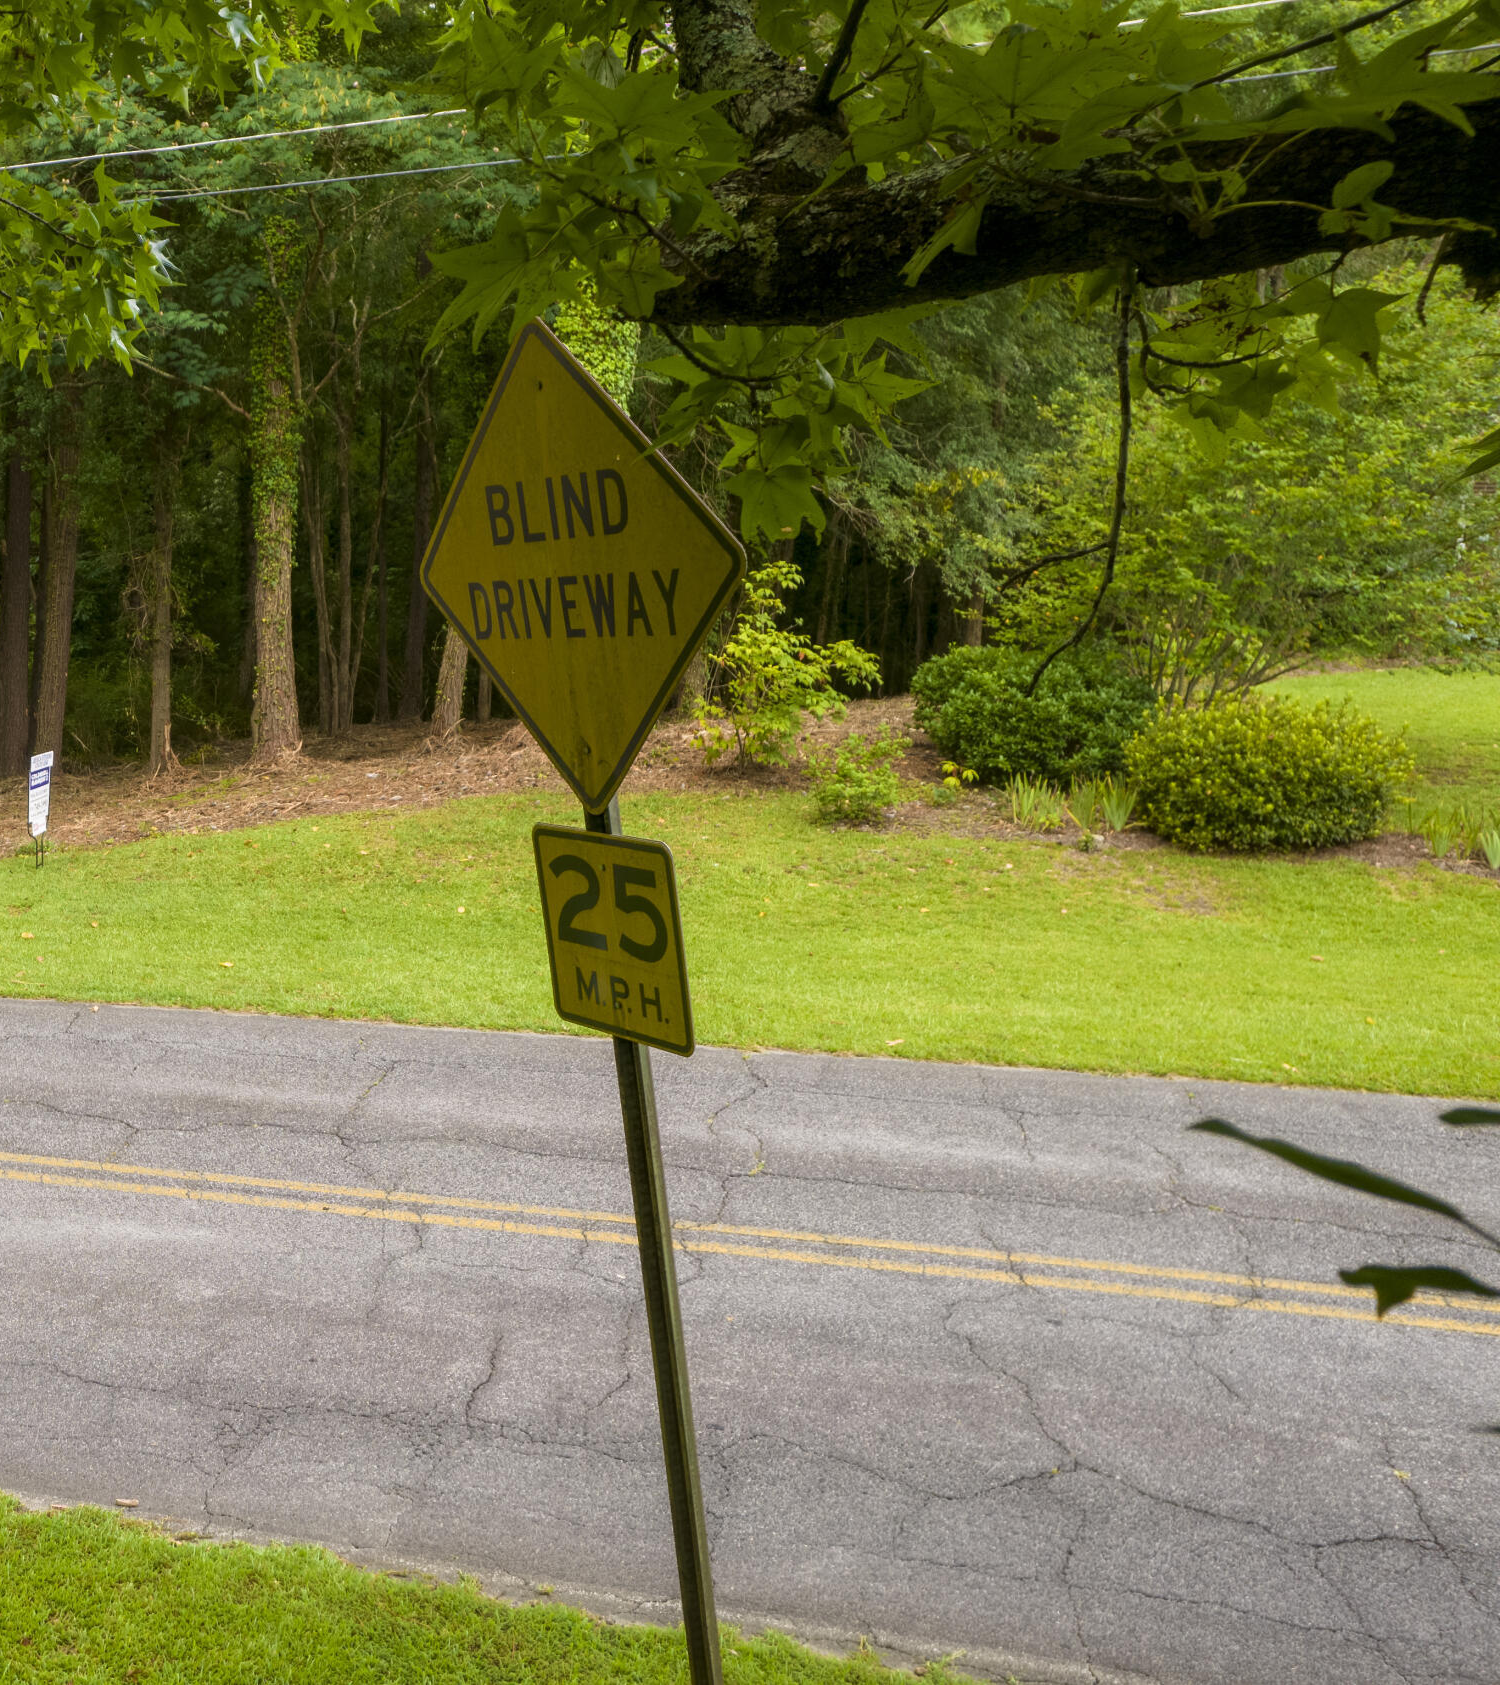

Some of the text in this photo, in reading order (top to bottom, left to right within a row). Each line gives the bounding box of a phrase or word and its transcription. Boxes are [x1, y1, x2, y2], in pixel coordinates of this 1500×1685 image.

[485, 469, 628, 546] BLIND
[468, 568, 680, 640] DRIVEWAY
[549, 854, 668, 963] 25
[575, 966, 670, 1024] M.P.H.
